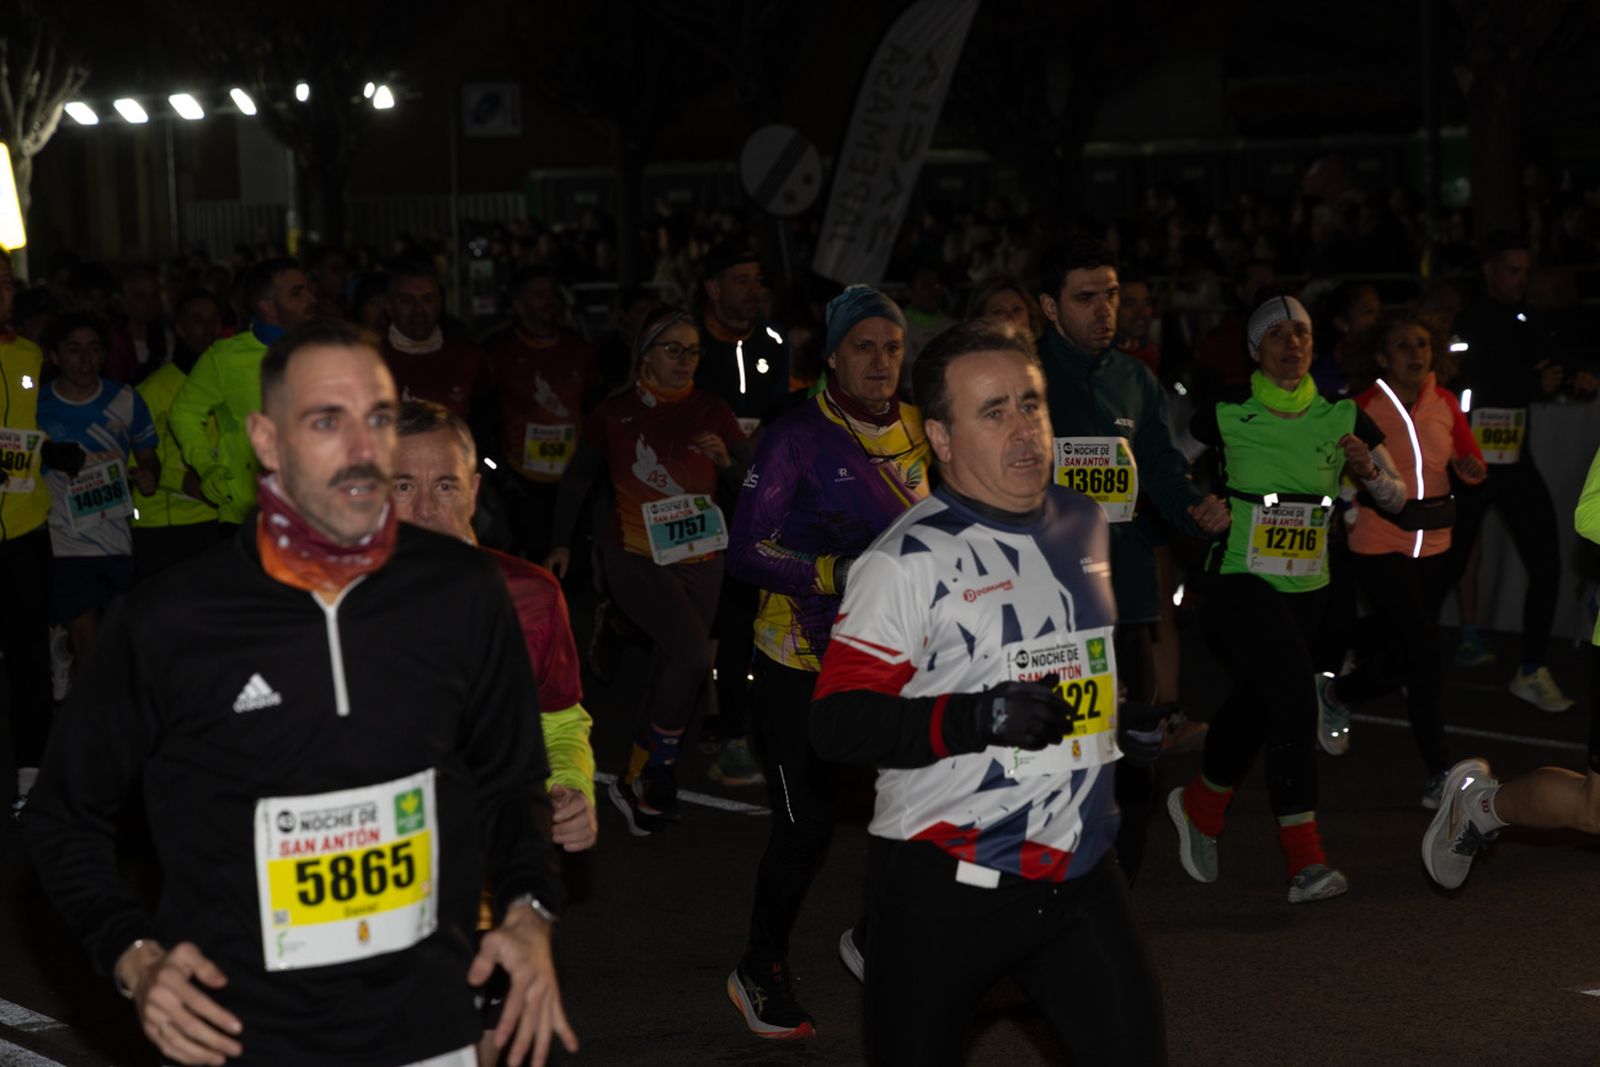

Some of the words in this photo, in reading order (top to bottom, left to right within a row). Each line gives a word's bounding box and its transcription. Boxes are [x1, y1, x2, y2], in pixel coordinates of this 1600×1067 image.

[1064, 457, 1081, 466] SAN
[1082, 455, 1109, 466] ANTÓN
[1073, 446, 1098, 455] NOCHE
[1100, 447, 1109, 455] DE
[647, 470, 668, 488] 43
[1064, 468, 1128, 493] 13689
[74, 482, 122, 511] 14036
[665, 514, 706, 541] 7757
[1261, 516, 1278, 526] SAN
[1265, 527, 1317, 551] 12716
[1031, 652, 1066, 668] NOCHE
[1066, 648, 1080, 662] DE
[300, 812, 353, 832] NOCHE
[358, 807, 378, 824] DE
[279, 840, 317, 857] SAN
[321, 827, 381, 851] ANTÓN
[296, 841, 414, 906] 5865
